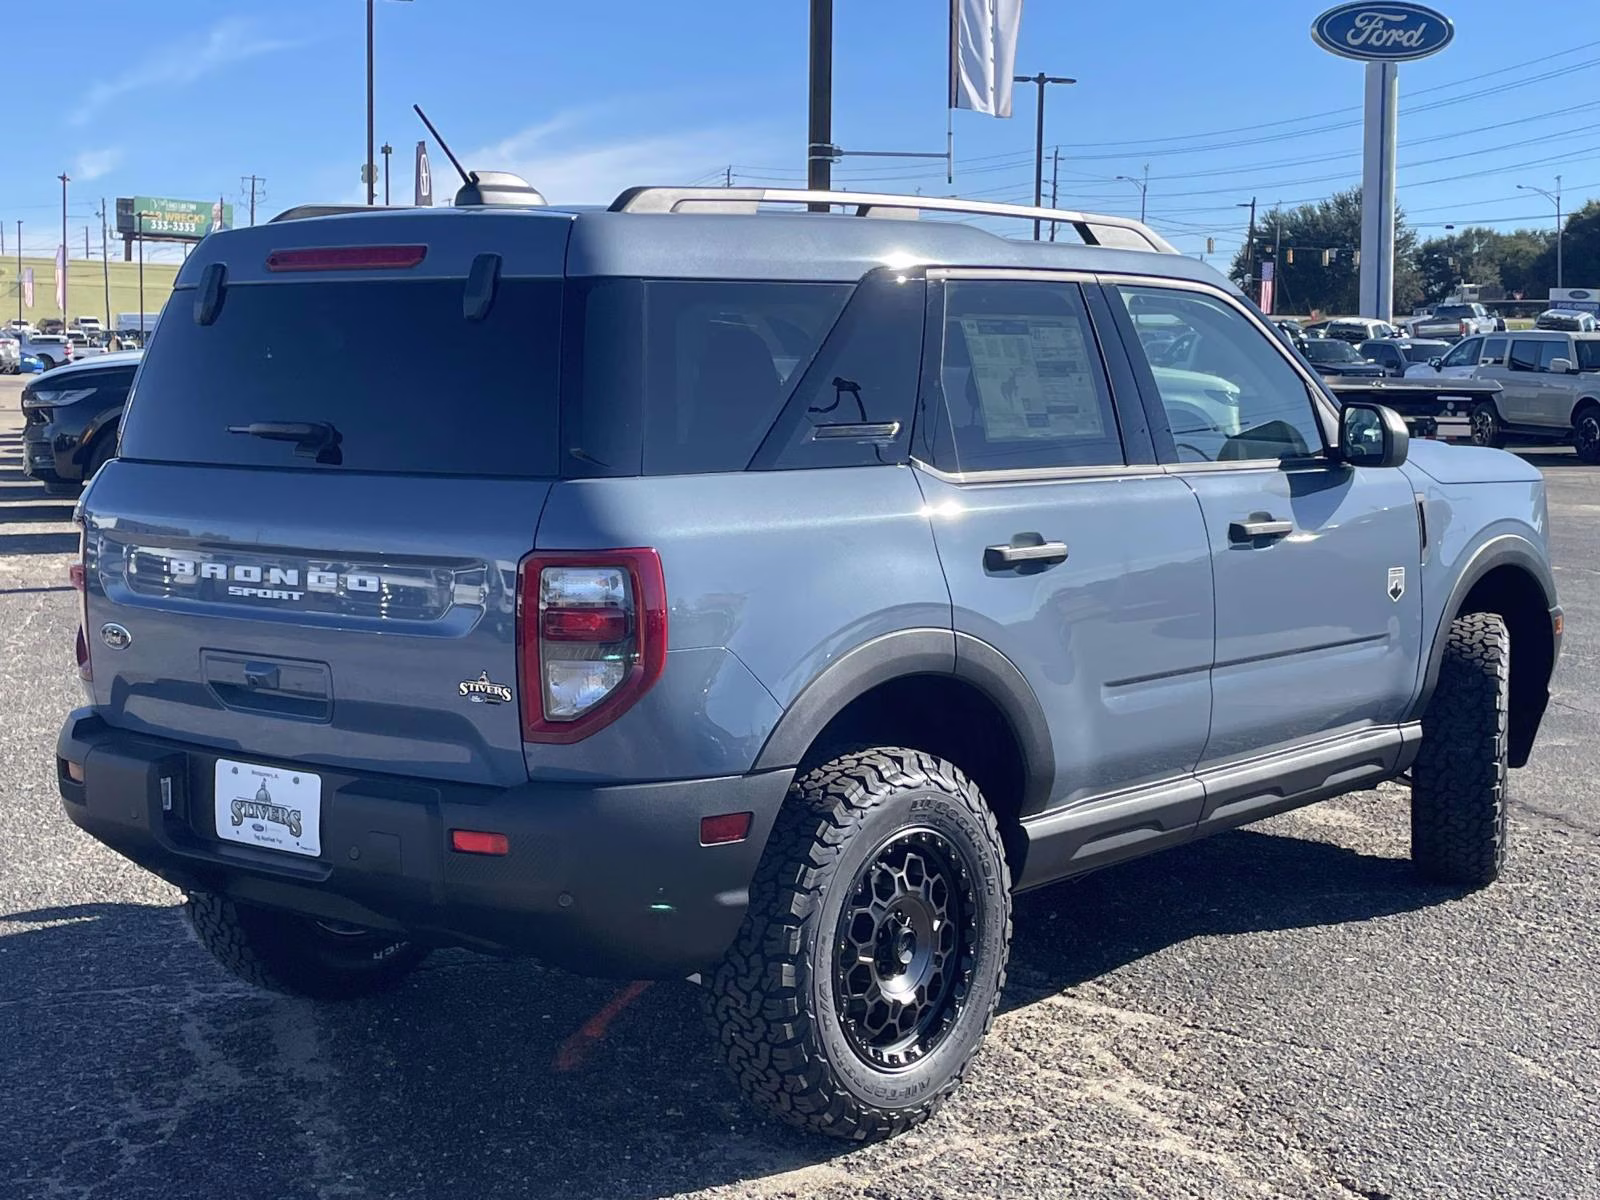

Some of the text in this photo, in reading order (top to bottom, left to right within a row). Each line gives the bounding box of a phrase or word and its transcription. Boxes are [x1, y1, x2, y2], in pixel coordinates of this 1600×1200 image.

[1347, 12, 1427, 47] Ford
[151, 220, 196, 233] 333-3333
[165, 211, 206, 224] WRECK?
[170, 560, 380, 592] BRONCO
[228, 586, 304, 600] SPORT
[459, 682, 512, 702] STIVERS
[231, 799, 302, 838] STIVERS
